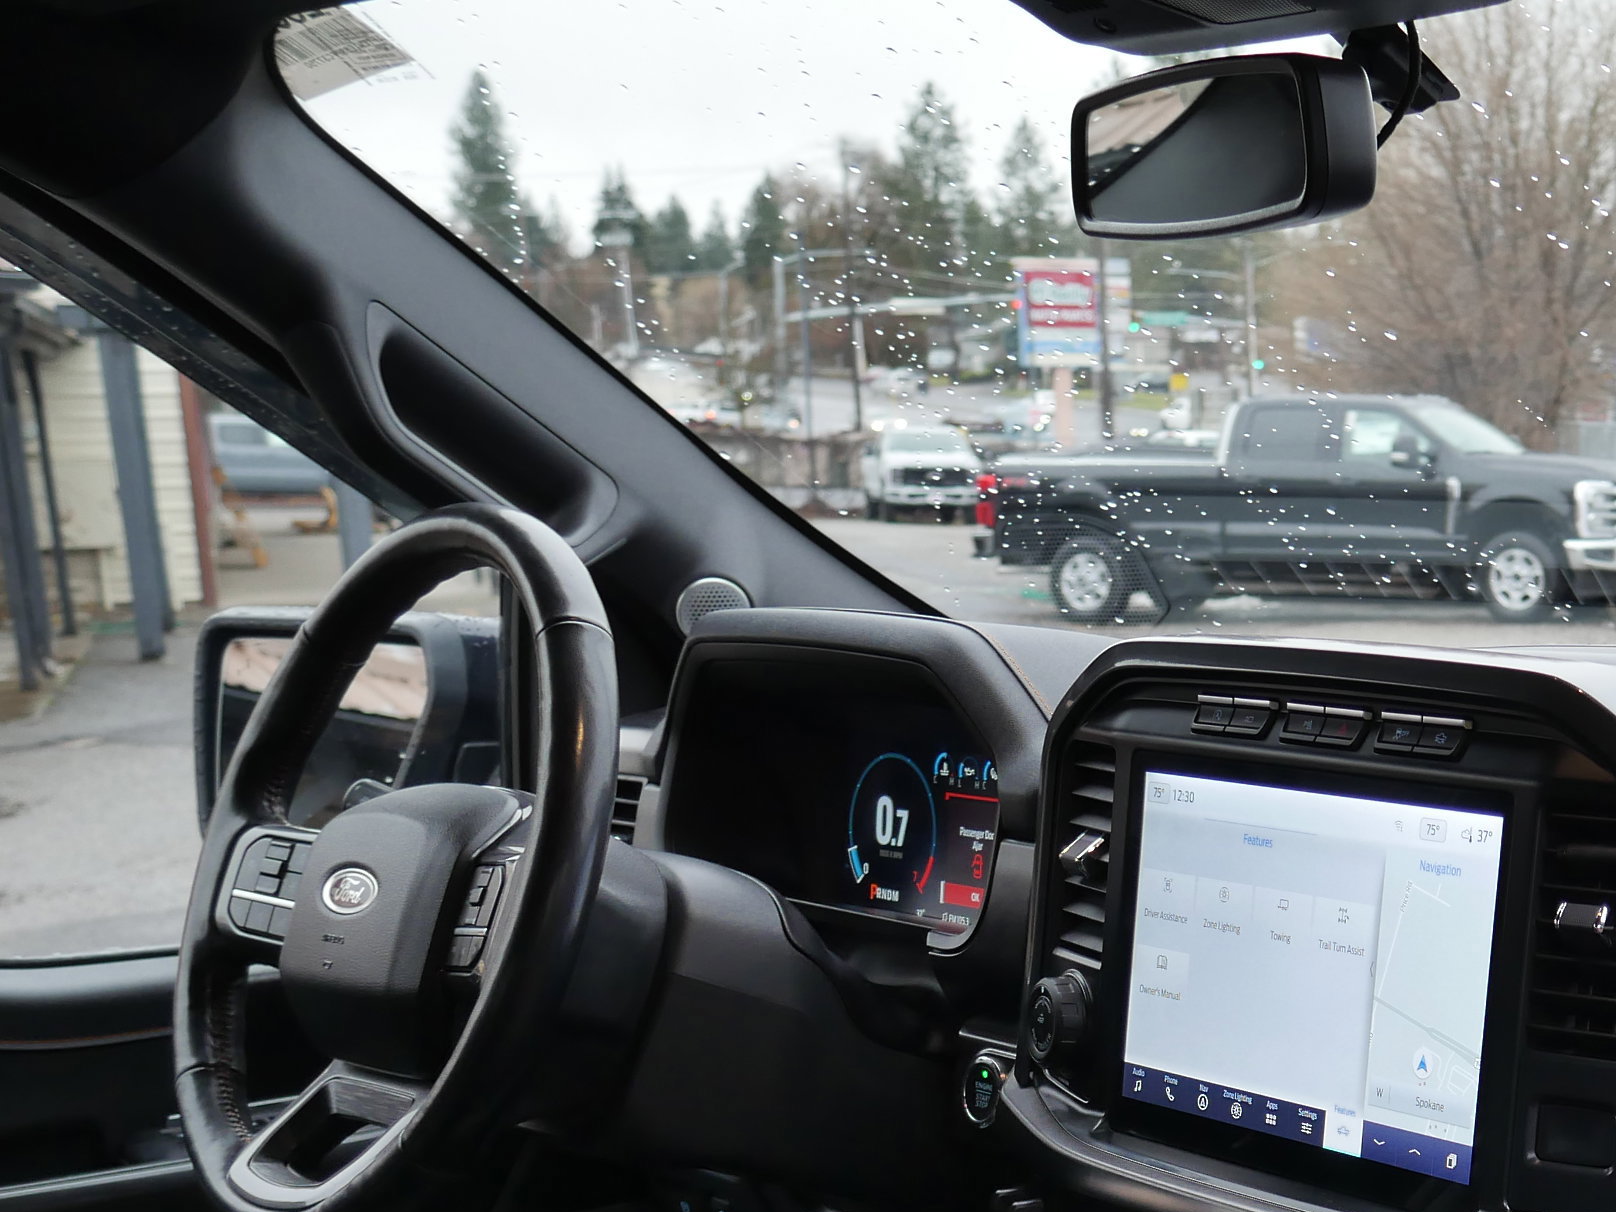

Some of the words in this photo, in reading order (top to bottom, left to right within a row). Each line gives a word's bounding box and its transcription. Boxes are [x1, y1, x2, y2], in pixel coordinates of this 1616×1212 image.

[1173, 789, 1195, 803] 12:30
[875, 795, 909, 847] 0.7
[1426, 823, 1440, 836] 75°
[1477, 829, 1493, 843] 37°
[1243, 833, 1273, 848] Features
[1419, 859, 1462, 877] Navigation
[334, 877, 365, 904] Ford
[1144, 907, 1159, 918] Driver
[1160, 911, 1188, 924] Assistance
[1203, 918, 1217, 930] Zone
[1218, 921, 1241, 935] Lighting
[1270, 930, 1291, 944] Towing
[1319, 939, 1331, 950] Trail
[1333, 942, 1346, 953] Turn
[1347, 945, 1365, 957] Assist
[1140, 984, 1160, 996] Owner's
[1161, 988, 1181, 1001] Manual
[1132, 1067, 1145, 1077] Audio
[1164, 1075, 1178, 1086] Phone
[1223, 1089, 1234, 1100] Zone
[1234, 1092, 1253, 1105] Lighting
[1377, 1087, 1383, 1098] W
[1266, 1100, 1278, 1111] Apps
[1415, 1096, 1445, 1113] Spokane
[1298, 1108, 1318, 1121] Settings
